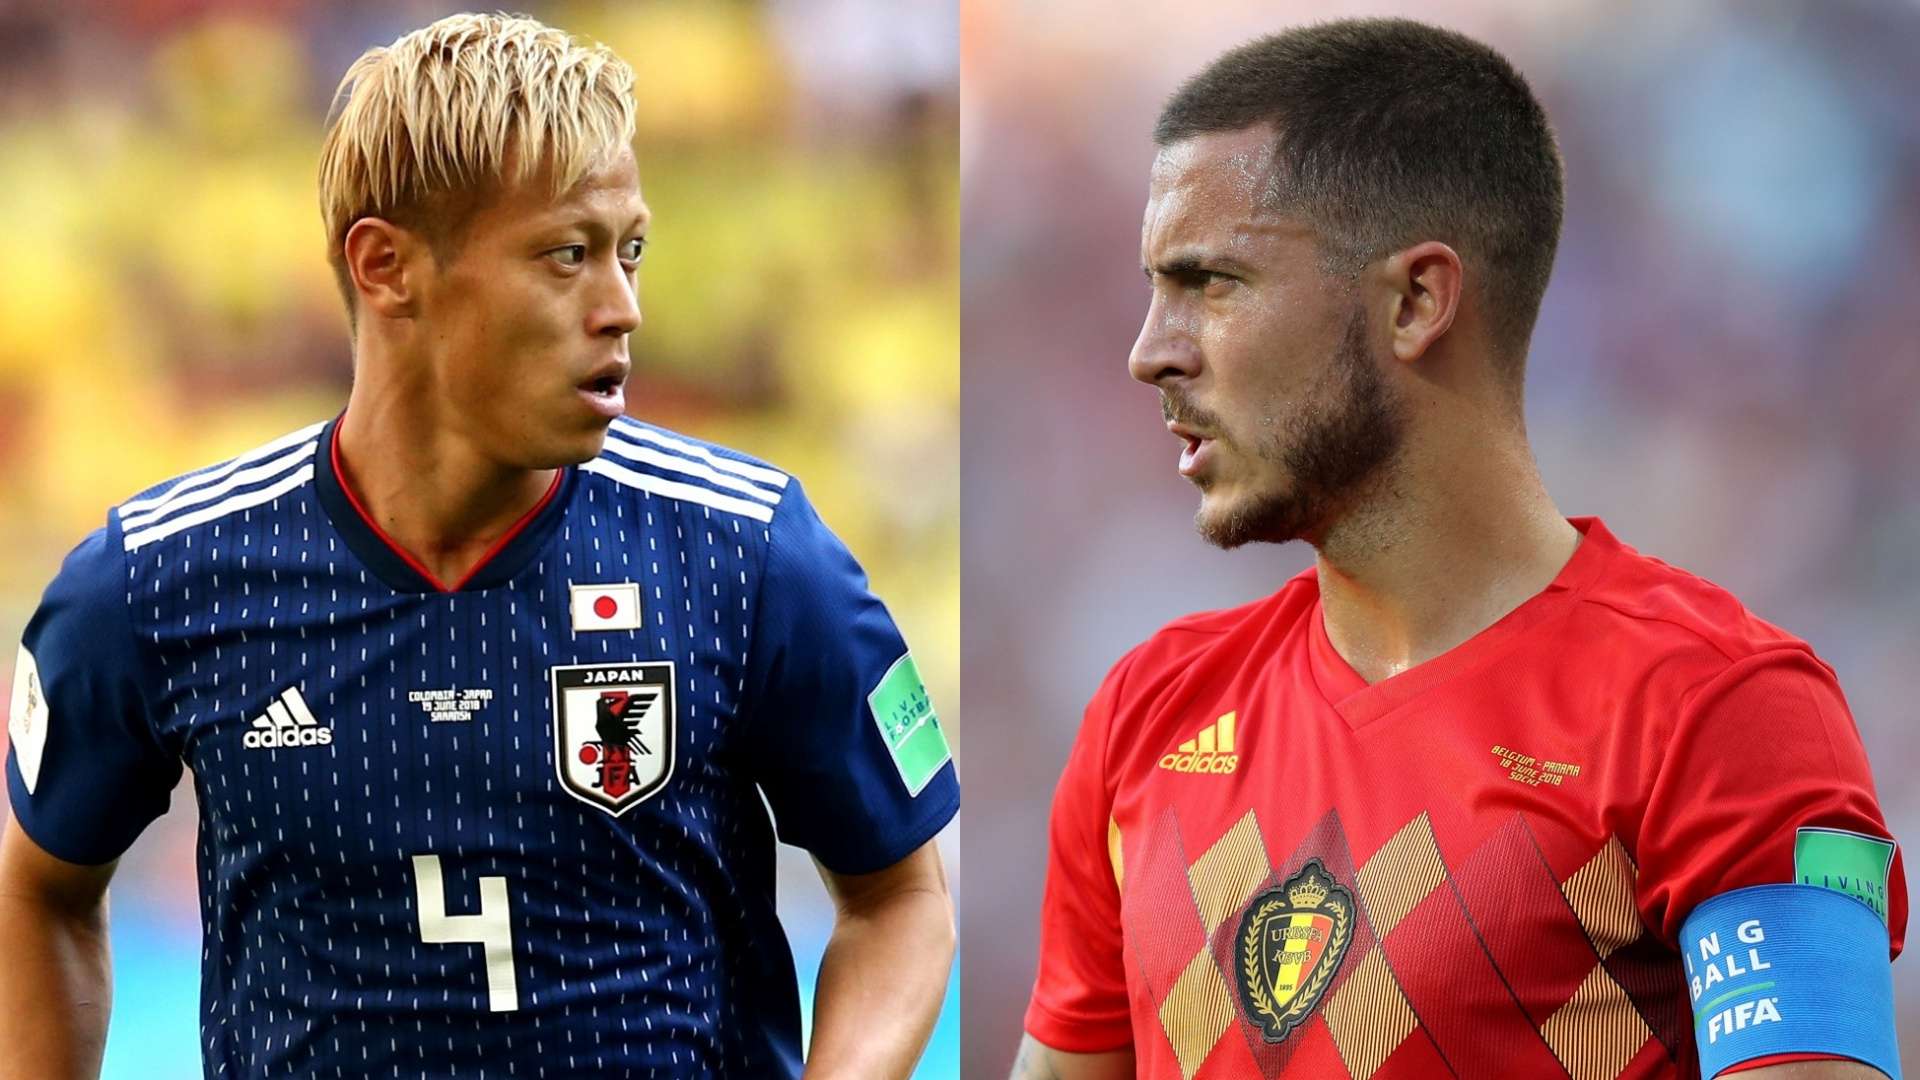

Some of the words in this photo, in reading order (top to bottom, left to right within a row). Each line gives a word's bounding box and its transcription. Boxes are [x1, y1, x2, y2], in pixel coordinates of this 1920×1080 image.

[584, 670, 643, 683] JAPAN
[422, 700, 432, 711] 19
[433, 700, 457, 711] JUNE
[458, 700, 480, 710] 2018
[462, 689, 493, 700] JAPAN
[243, 725, 332, 748] adidas
[1159, 750, 1238, 774] adidas
[1491, 745, 1536, 767] BELGIUM
[1542, 761, 1580, 776] PANAMA
[1500, 758, 1512, 768] 18
[1512, 763, 1539, 778] JUNE
[1538, 772, 1563, 786] 2018
[591, 765, 641, 788] JFA
[1509, 771, 1540, 787] SOCHI
[412, 854, 519, 1012] 4
[1690, 948, 1771, 1001] BALL
[1708, 998, 1782, 1044] FIFA
